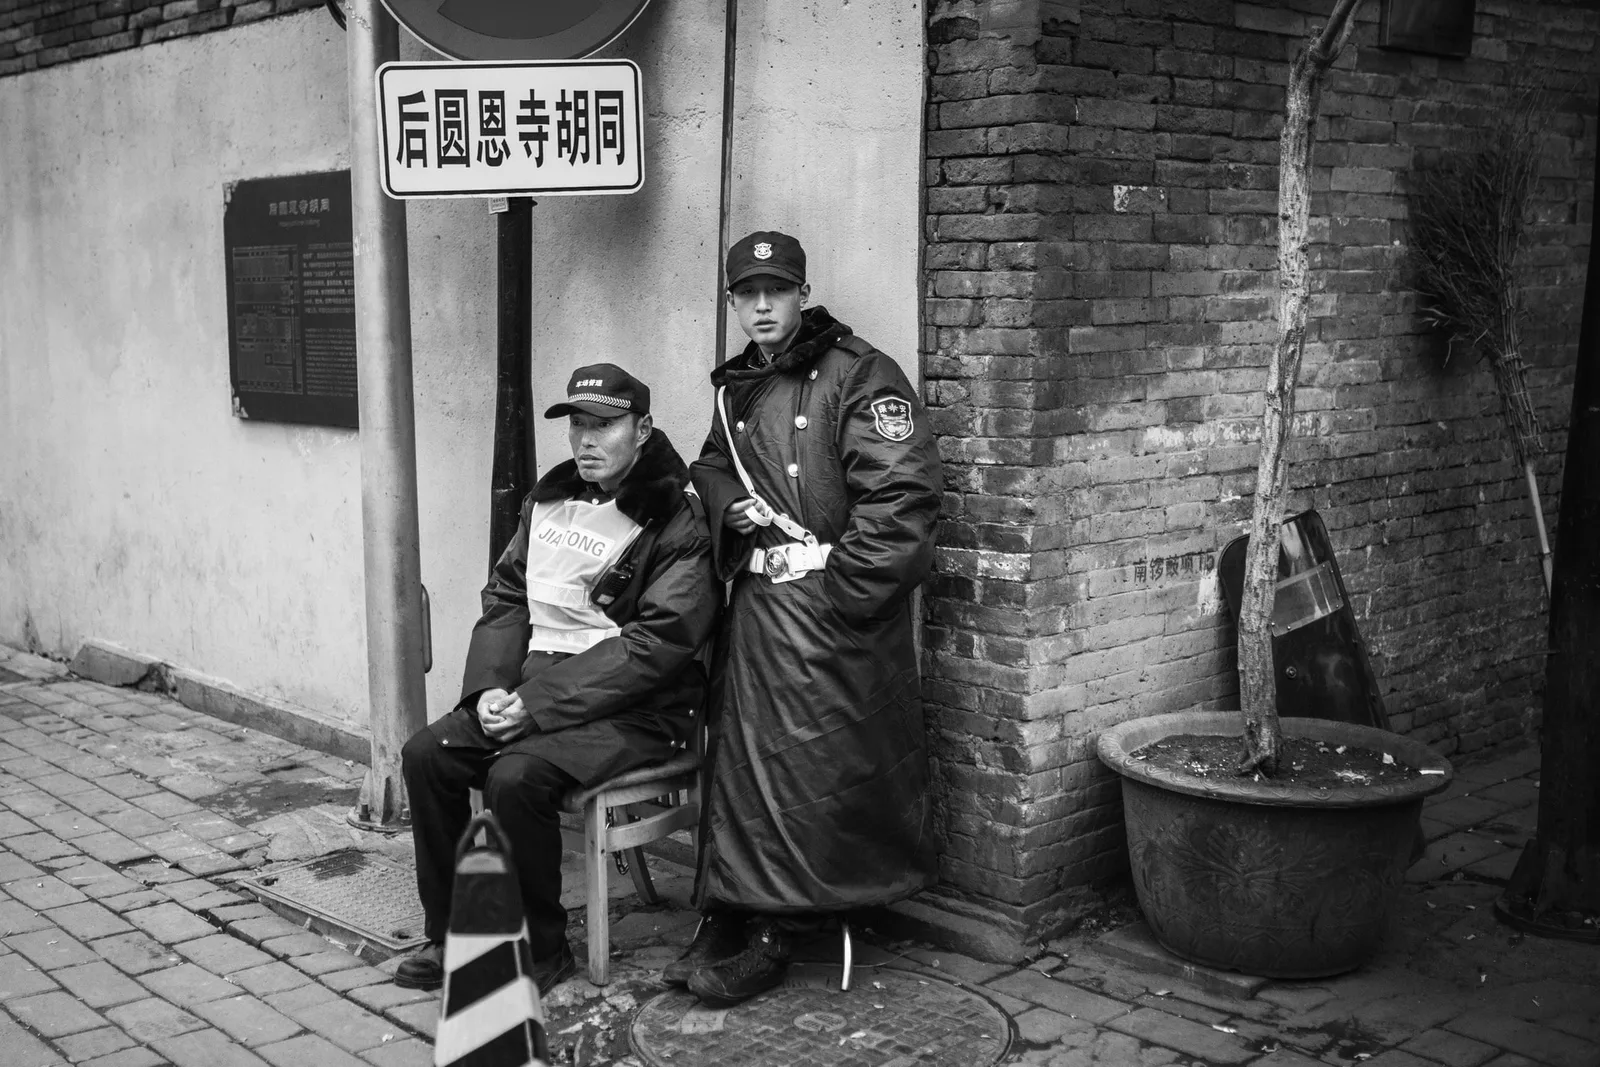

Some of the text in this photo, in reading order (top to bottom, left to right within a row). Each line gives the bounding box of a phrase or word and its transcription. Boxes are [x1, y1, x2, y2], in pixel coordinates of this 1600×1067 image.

[396, 88, 625, 169] 后圆恩寺胡同
